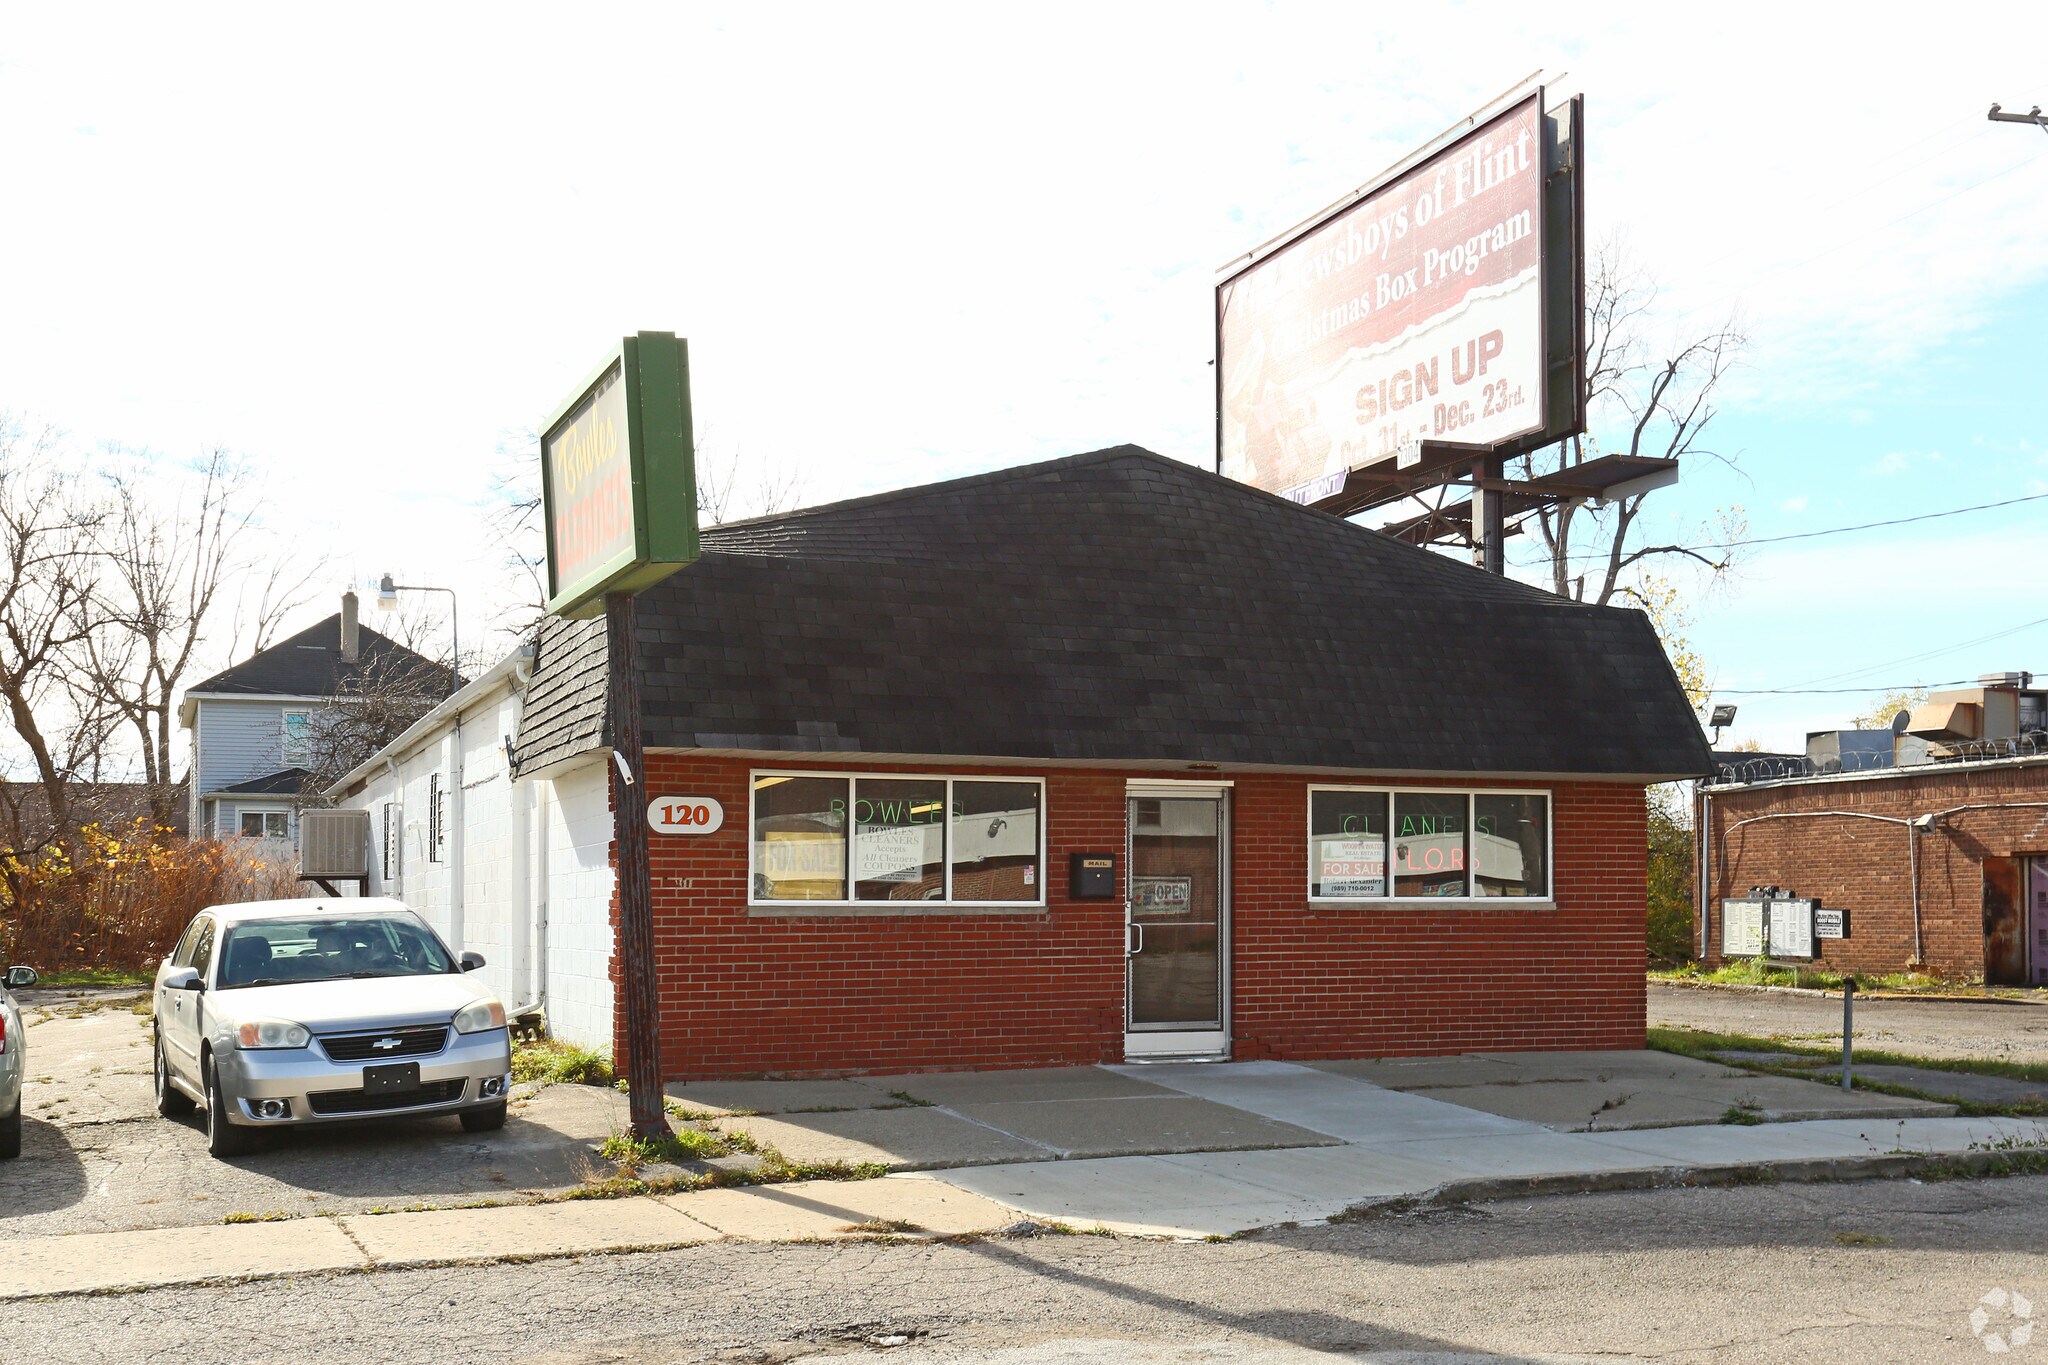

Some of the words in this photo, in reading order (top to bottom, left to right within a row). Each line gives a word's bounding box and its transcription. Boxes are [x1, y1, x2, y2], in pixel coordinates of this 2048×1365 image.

[1282, 204, 1409, 290] ewsboys
[1415, 164, 1448, 226] of
[1450, 126, 1531, 208] Flint
[1375, 267, 1418, 310] Box
[1423, 208, 1531, 287] Program
[1355, 355, 1439, 426] SIGN
[1451, 328, 1503, 386] UP
[1434, 399, 1475, 437] Dec.
[1482, 377, 1525, 419] 23rd.
[557, 400, 617, 496] Bowles
[660, 804, 710, 826] 120
[830, 799, 964, 825] BOWLES
[868, 826, 914, 836] BOWLES
[1343, 815, 1490, 838] CLANES
[861, 834, 919, 845] CLEANERS
[874, 844, 906, 853] Accepts
[769, 843, 797, 872] FOR
[801, 843, 838, 872] SALE
[862, 853, 877, 862] All
[878, 853, 918, 863] Cleaners
[863, 861, 915, 872] COUPONS
[1323, 862, 1350, 875] FOR
[1354, 862, 1384, 875] SALE
[1394, 847, 1481, 871] ILORS
[1156, 884, 1187, 900] OPEN
